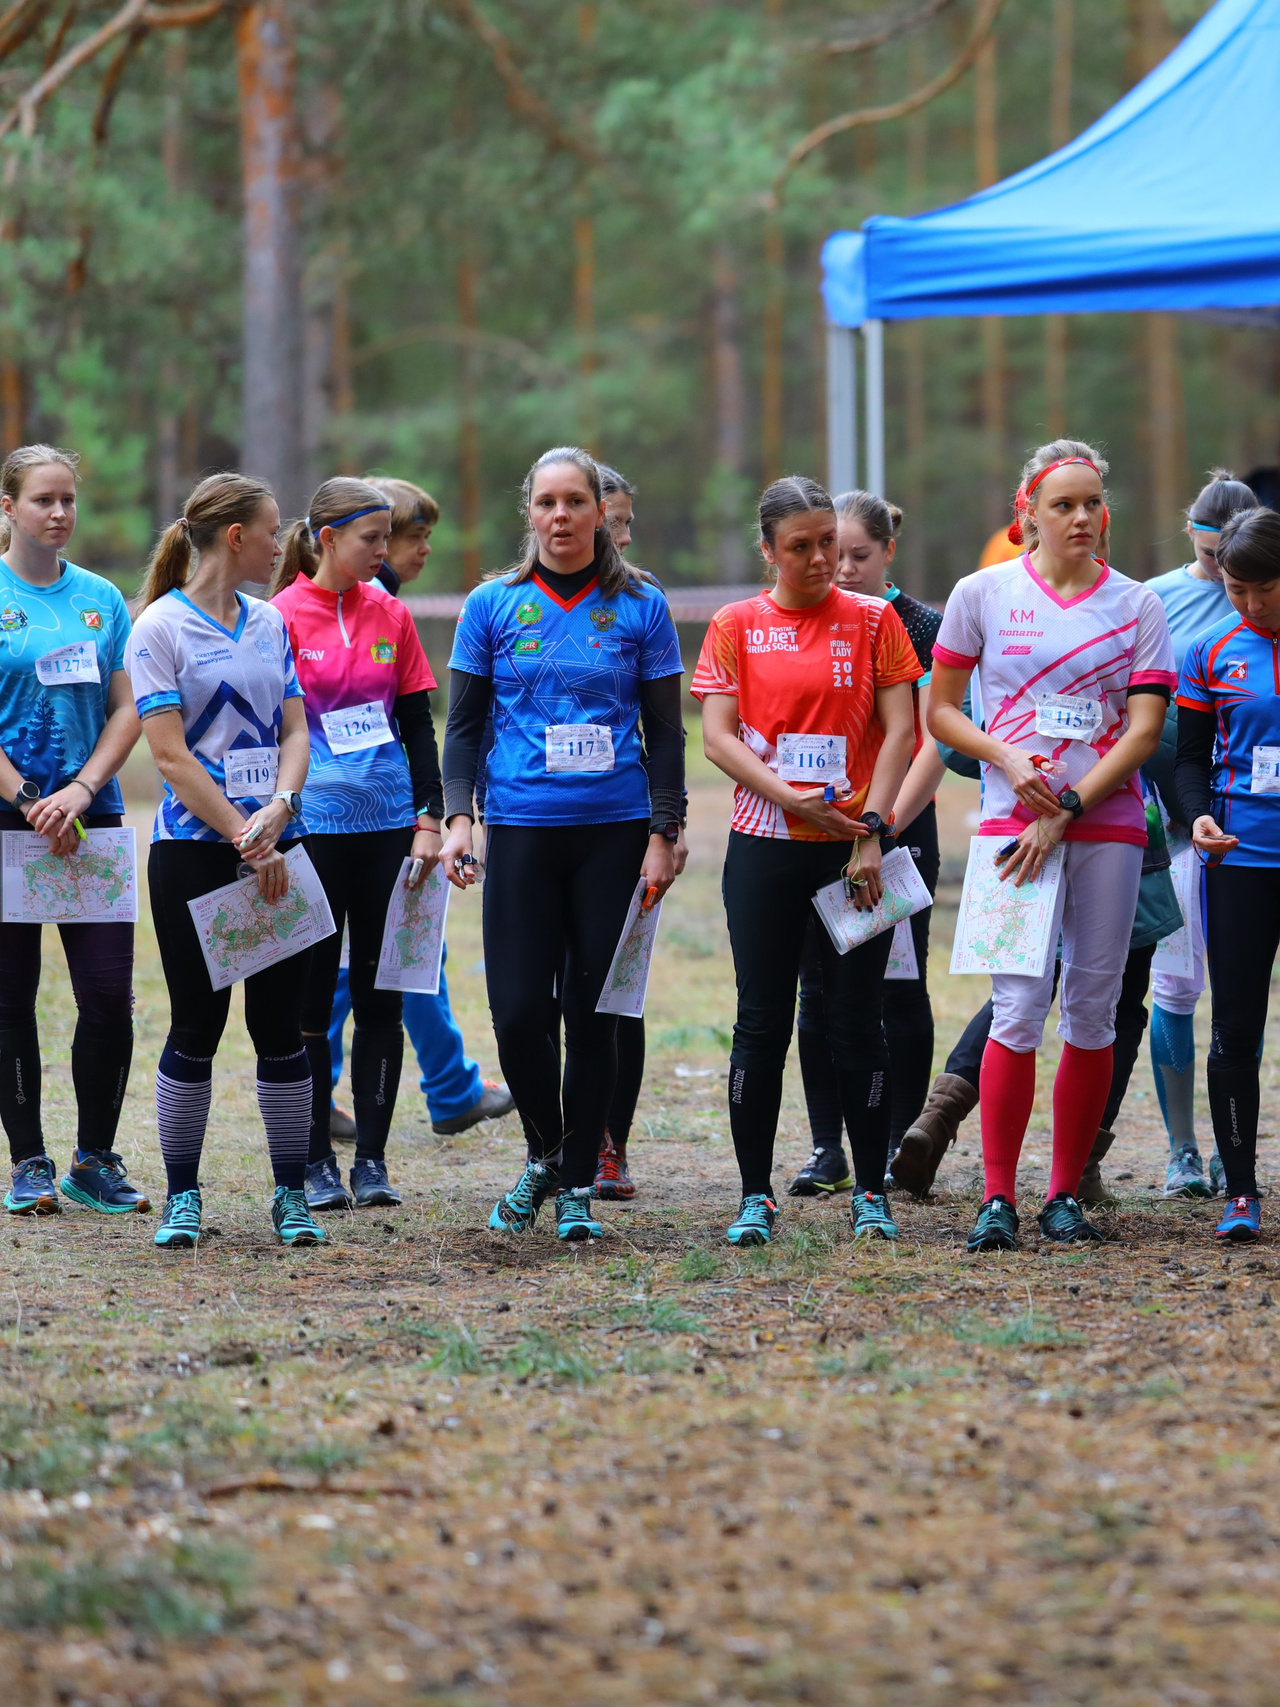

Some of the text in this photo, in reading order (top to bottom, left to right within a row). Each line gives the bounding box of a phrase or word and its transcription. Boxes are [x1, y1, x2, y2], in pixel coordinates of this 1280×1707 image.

[745, 628, 797, 645] 10 лет
[998, 629, 1044, 638] noname
[772, 642, 799, 652] SOCHI
[830, 647, 852, 657] LADY
[54, 659, 80, 673] 127
[343, 719, 371, 737] 126
[1057, 711, 1083, 728] 115
[569, 741, 594, 756] 117
[799, 752, 826, 769] 116
[246, 767, 269, 784] 119
[15, 1058, 23, 1092] NORD
[379, 1058, 387, 1093] NORD
[1229, 1097, 1238, 1134] NORD
